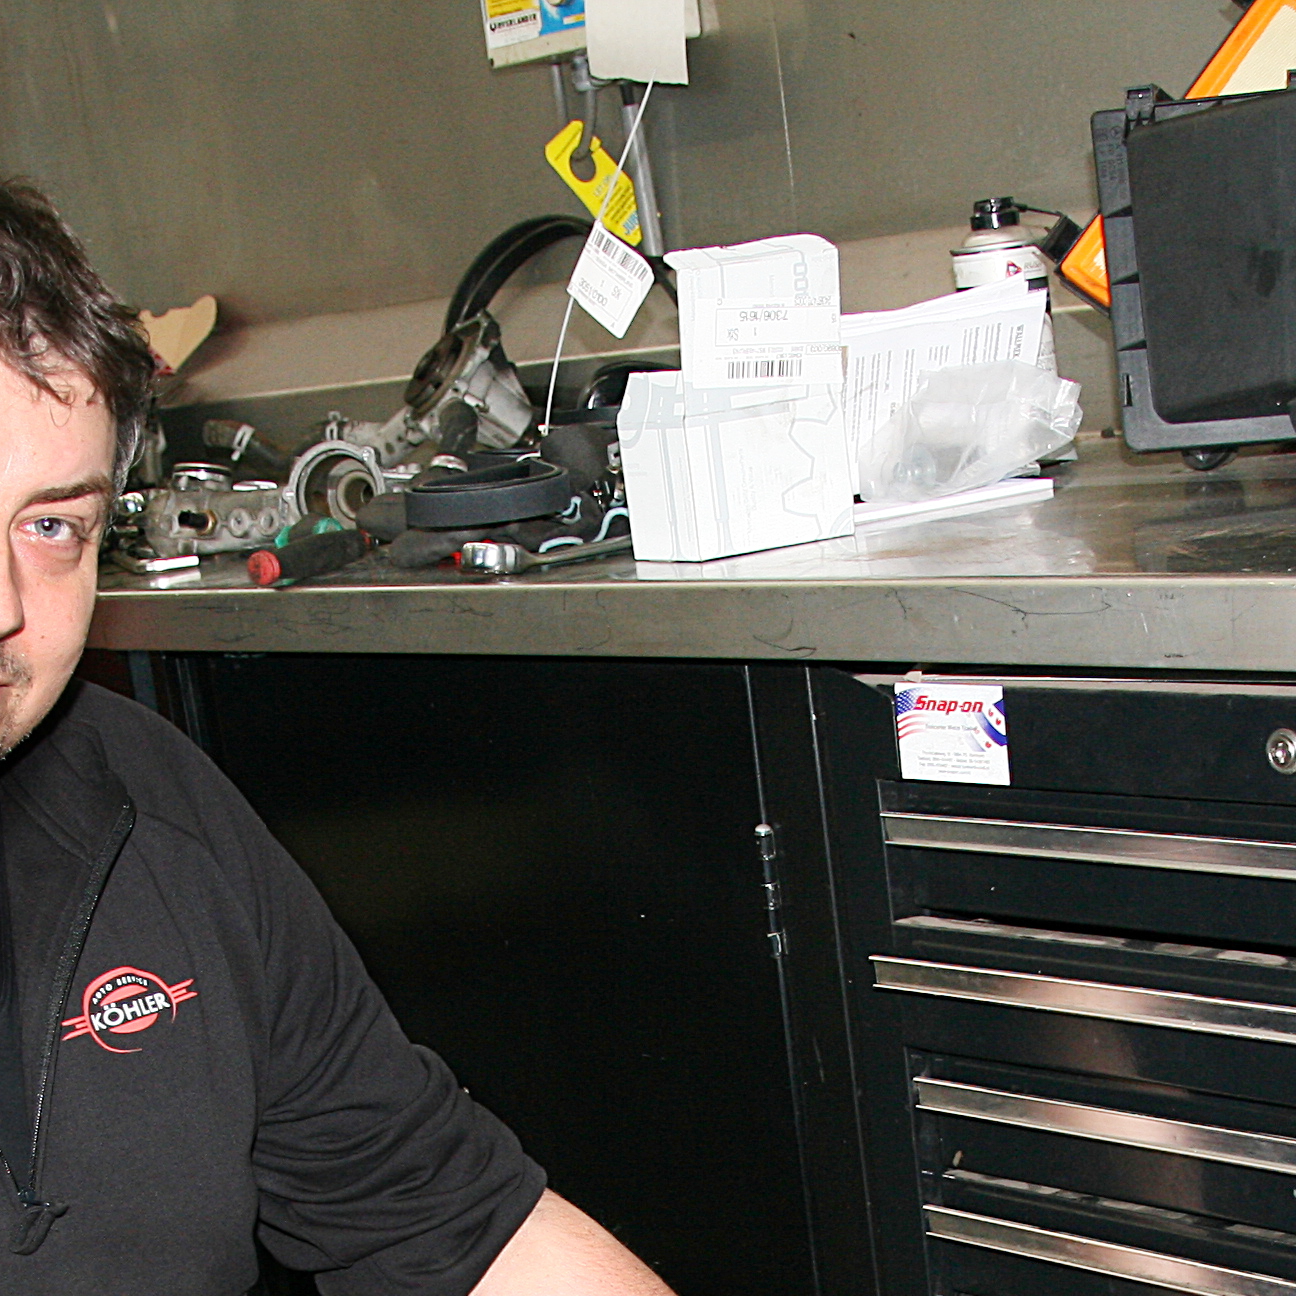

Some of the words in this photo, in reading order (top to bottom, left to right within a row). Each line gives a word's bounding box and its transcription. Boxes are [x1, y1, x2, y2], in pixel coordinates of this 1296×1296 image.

[913, 695, 984, 716] Snap-on
[92, 983, 113, 1005] AUTO
[90, 992, 171, 1032] KÖHLER
